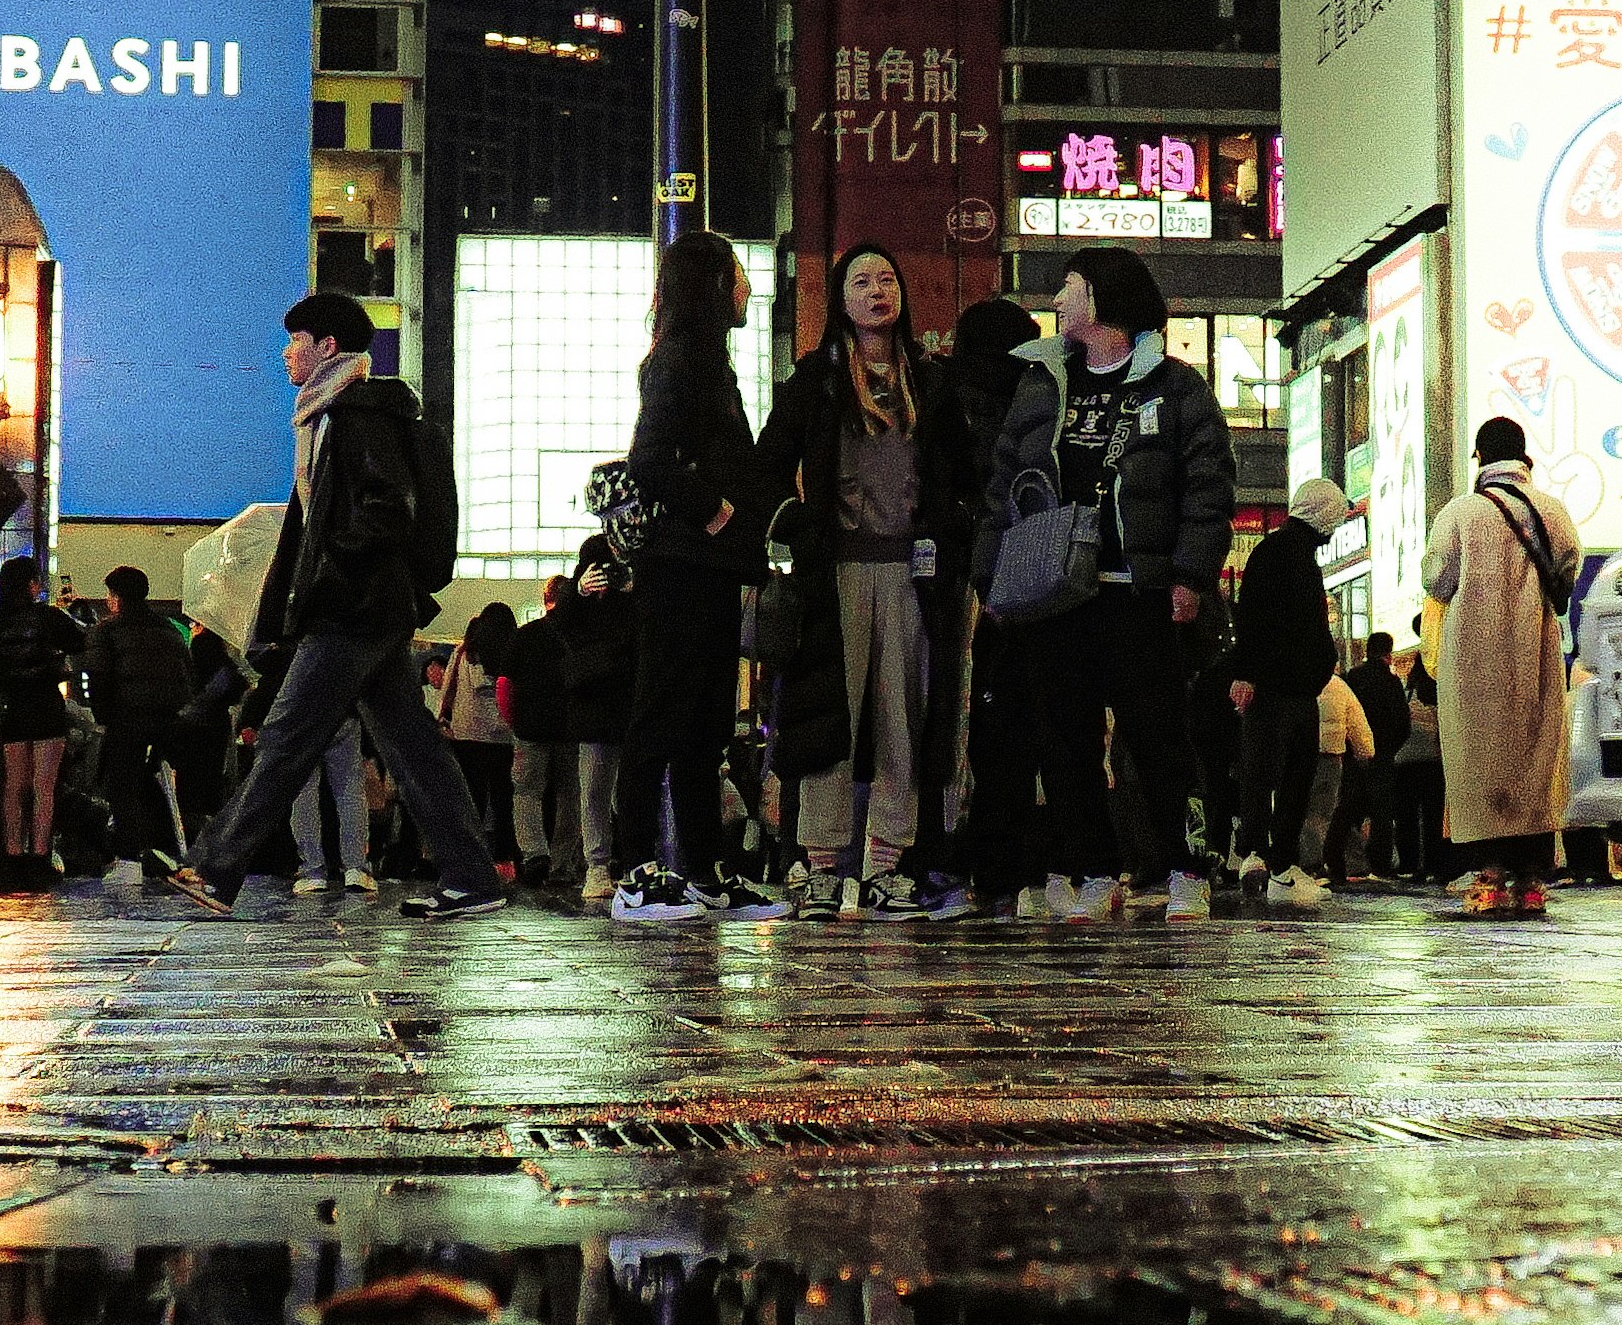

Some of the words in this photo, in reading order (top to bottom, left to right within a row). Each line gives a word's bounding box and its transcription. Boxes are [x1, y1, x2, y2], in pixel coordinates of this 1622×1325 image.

[835, 45, 965, 102] 龍角散
[1061, 131, 1195, 192] 焼肉
